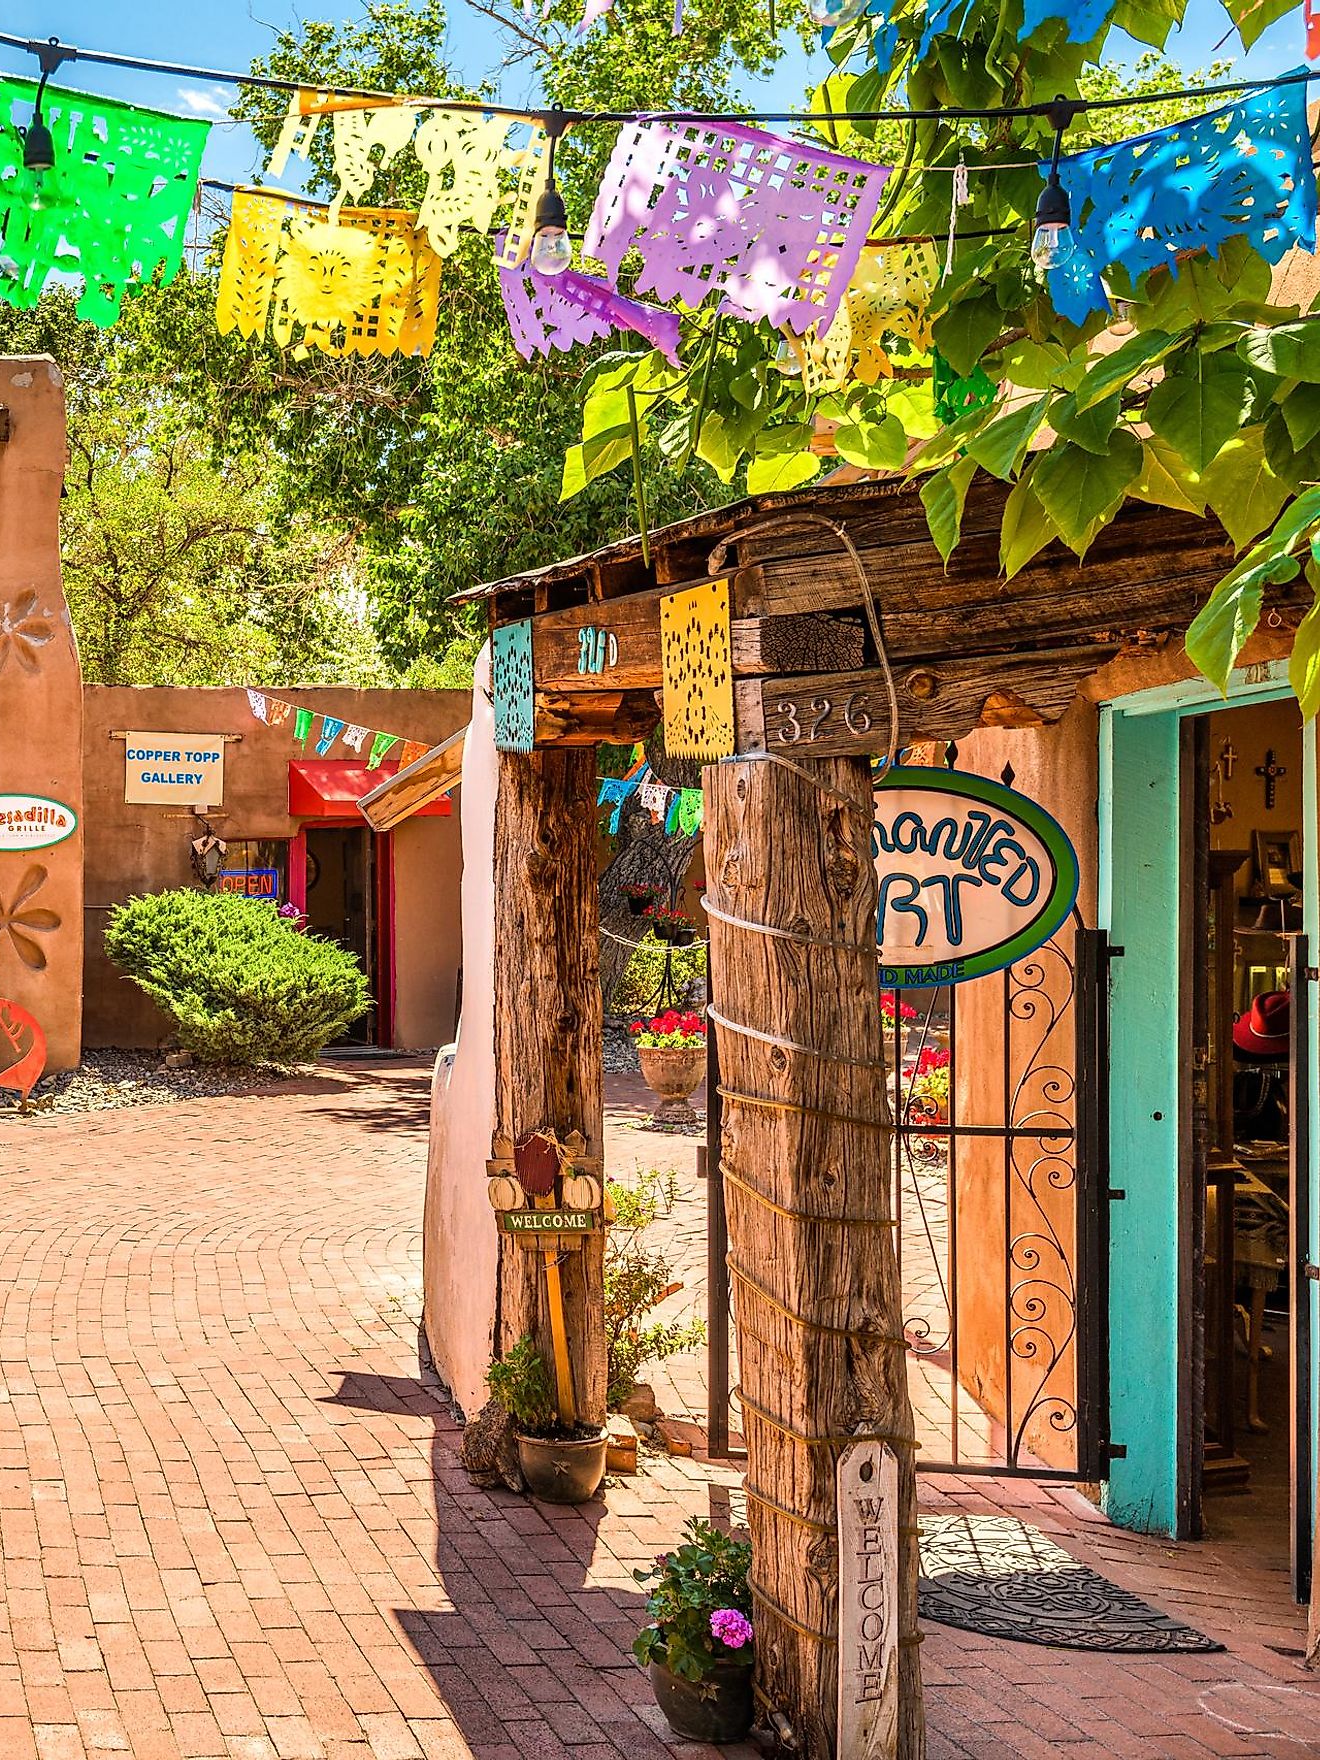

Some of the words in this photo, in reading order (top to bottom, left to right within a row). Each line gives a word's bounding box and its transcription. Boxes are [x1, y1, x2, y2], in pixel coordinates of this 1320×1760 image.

[778, 693, 871, 743] 326
[127, 749, 181, 761] COPPER
[185, 752, 220, 763] TOPP
[141, 772, 203, 784] GALLERY
[222, 876, 272, 894] OPEN
[906, 961, 967, 985] MADE
[510, 1214, 587, 1229] WELCOME
[853, 1496, 884, 1704] WELCOME
